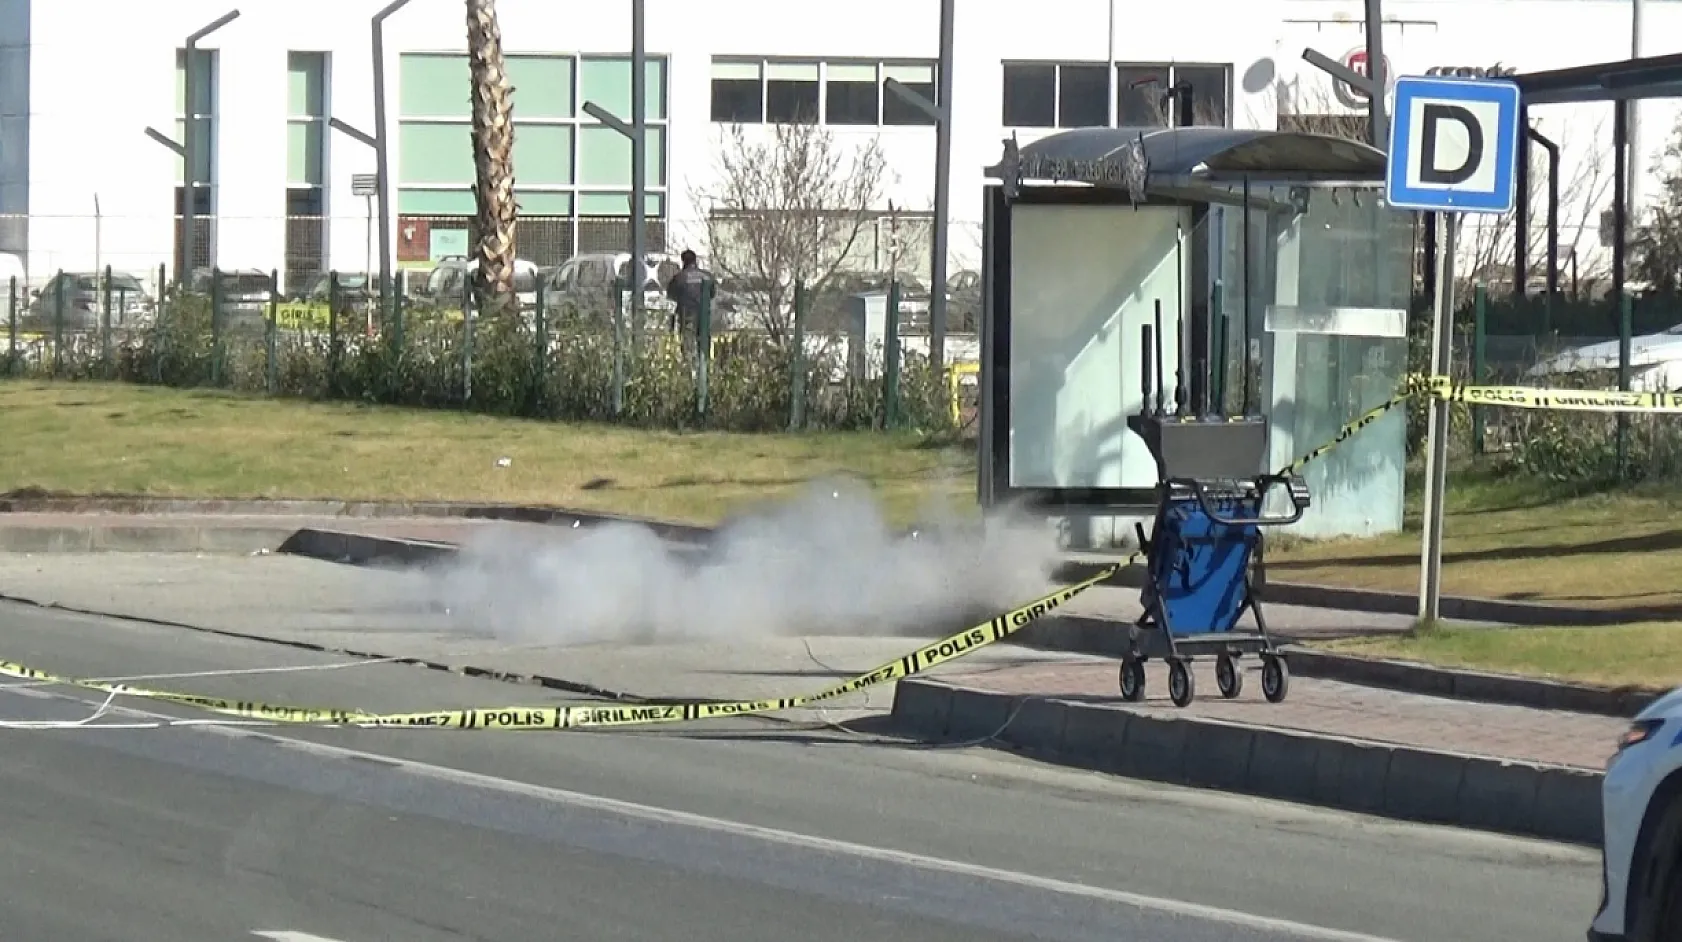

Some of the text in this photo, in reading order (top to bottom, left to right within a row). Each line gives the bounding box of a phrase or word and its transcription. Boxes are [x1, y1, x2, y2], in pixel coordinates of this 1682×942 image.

[1420, 103, 1483, 184] D
[484, 711, 545, 726] POLIS
[924, 629, 984, 663] POLIS
